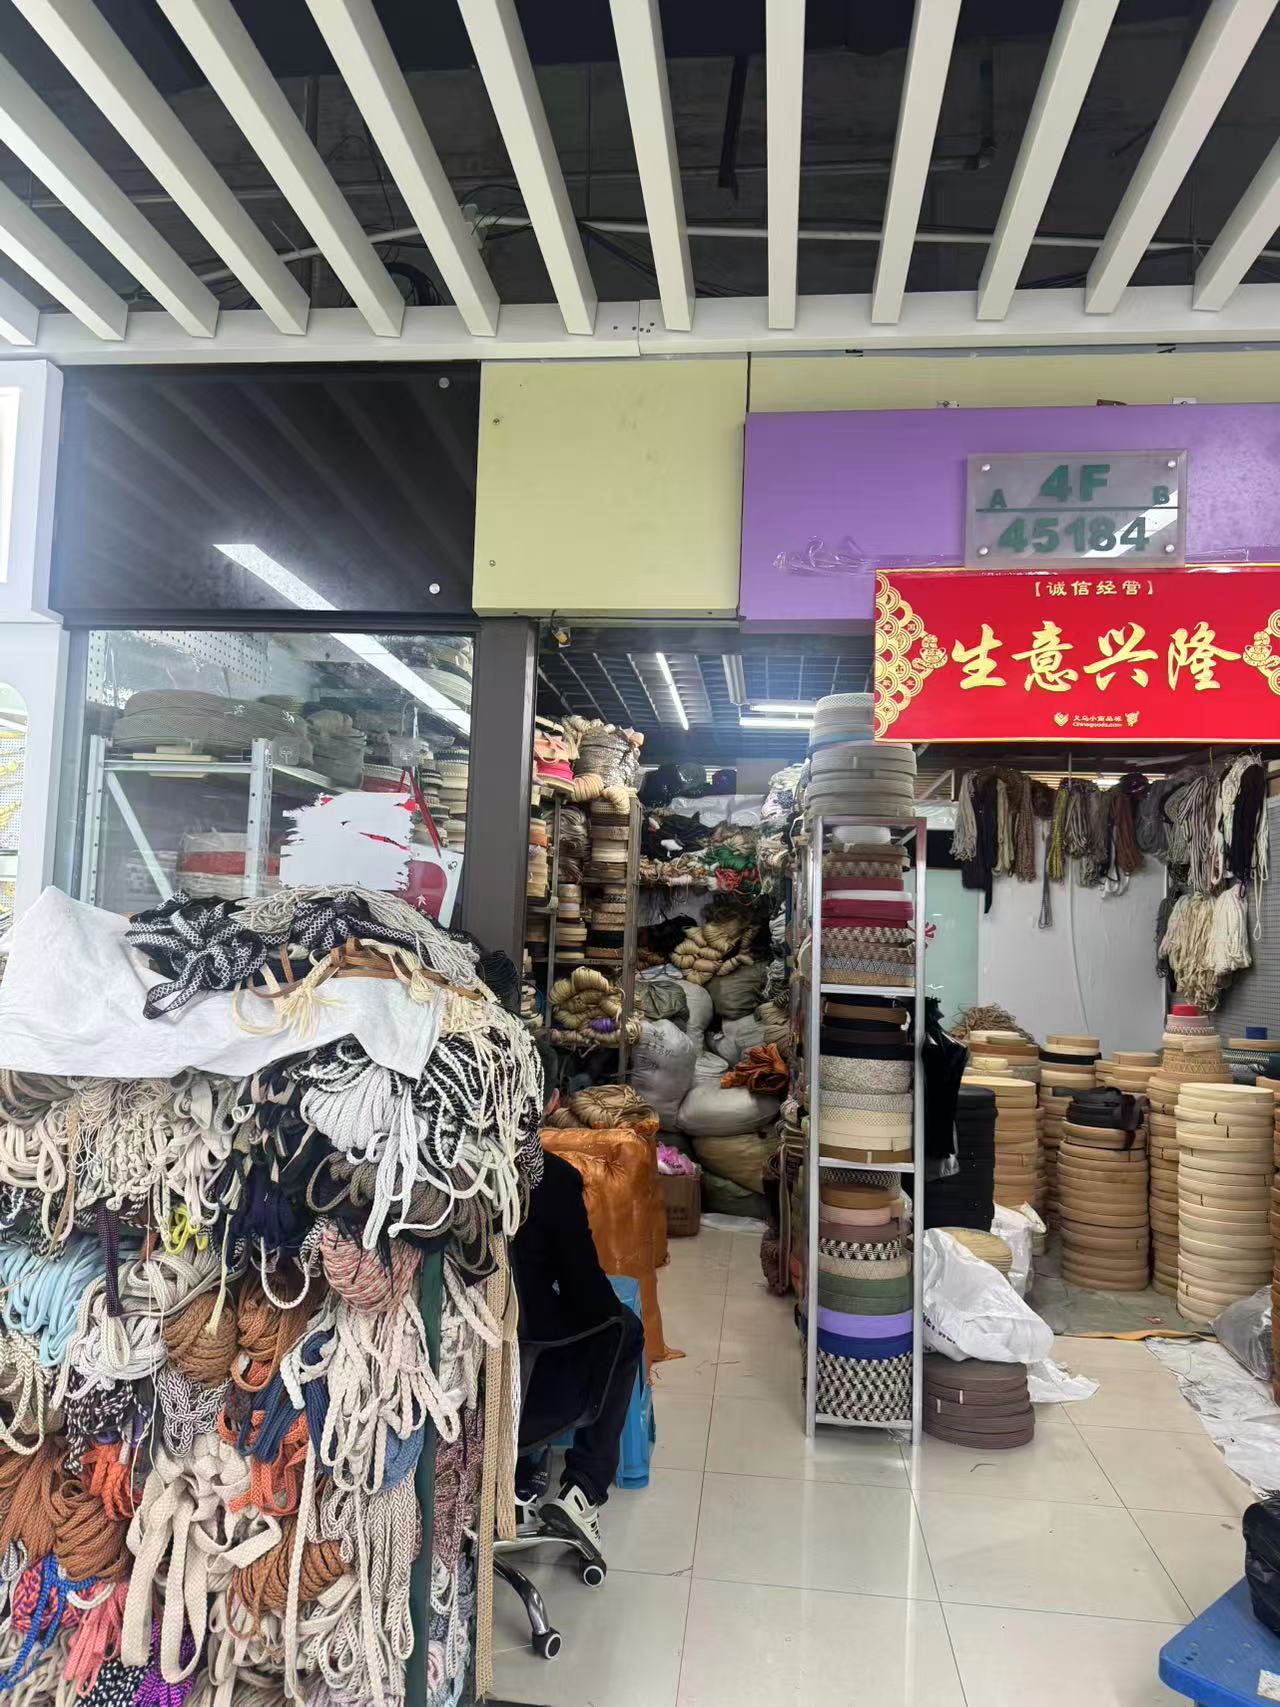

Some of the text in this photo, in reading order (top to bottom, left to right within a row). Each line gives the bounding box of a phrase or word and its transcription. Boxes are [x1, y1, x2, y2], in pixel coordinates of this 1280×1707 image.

[989, 488, 1007, 509] A
[1038, 463, 1111, 502] 4F
[1151, 484, 1170, 506] B
[998, 516, 1151, 554] 45184
[951, 620, 1242, 692] 生意兴隆
